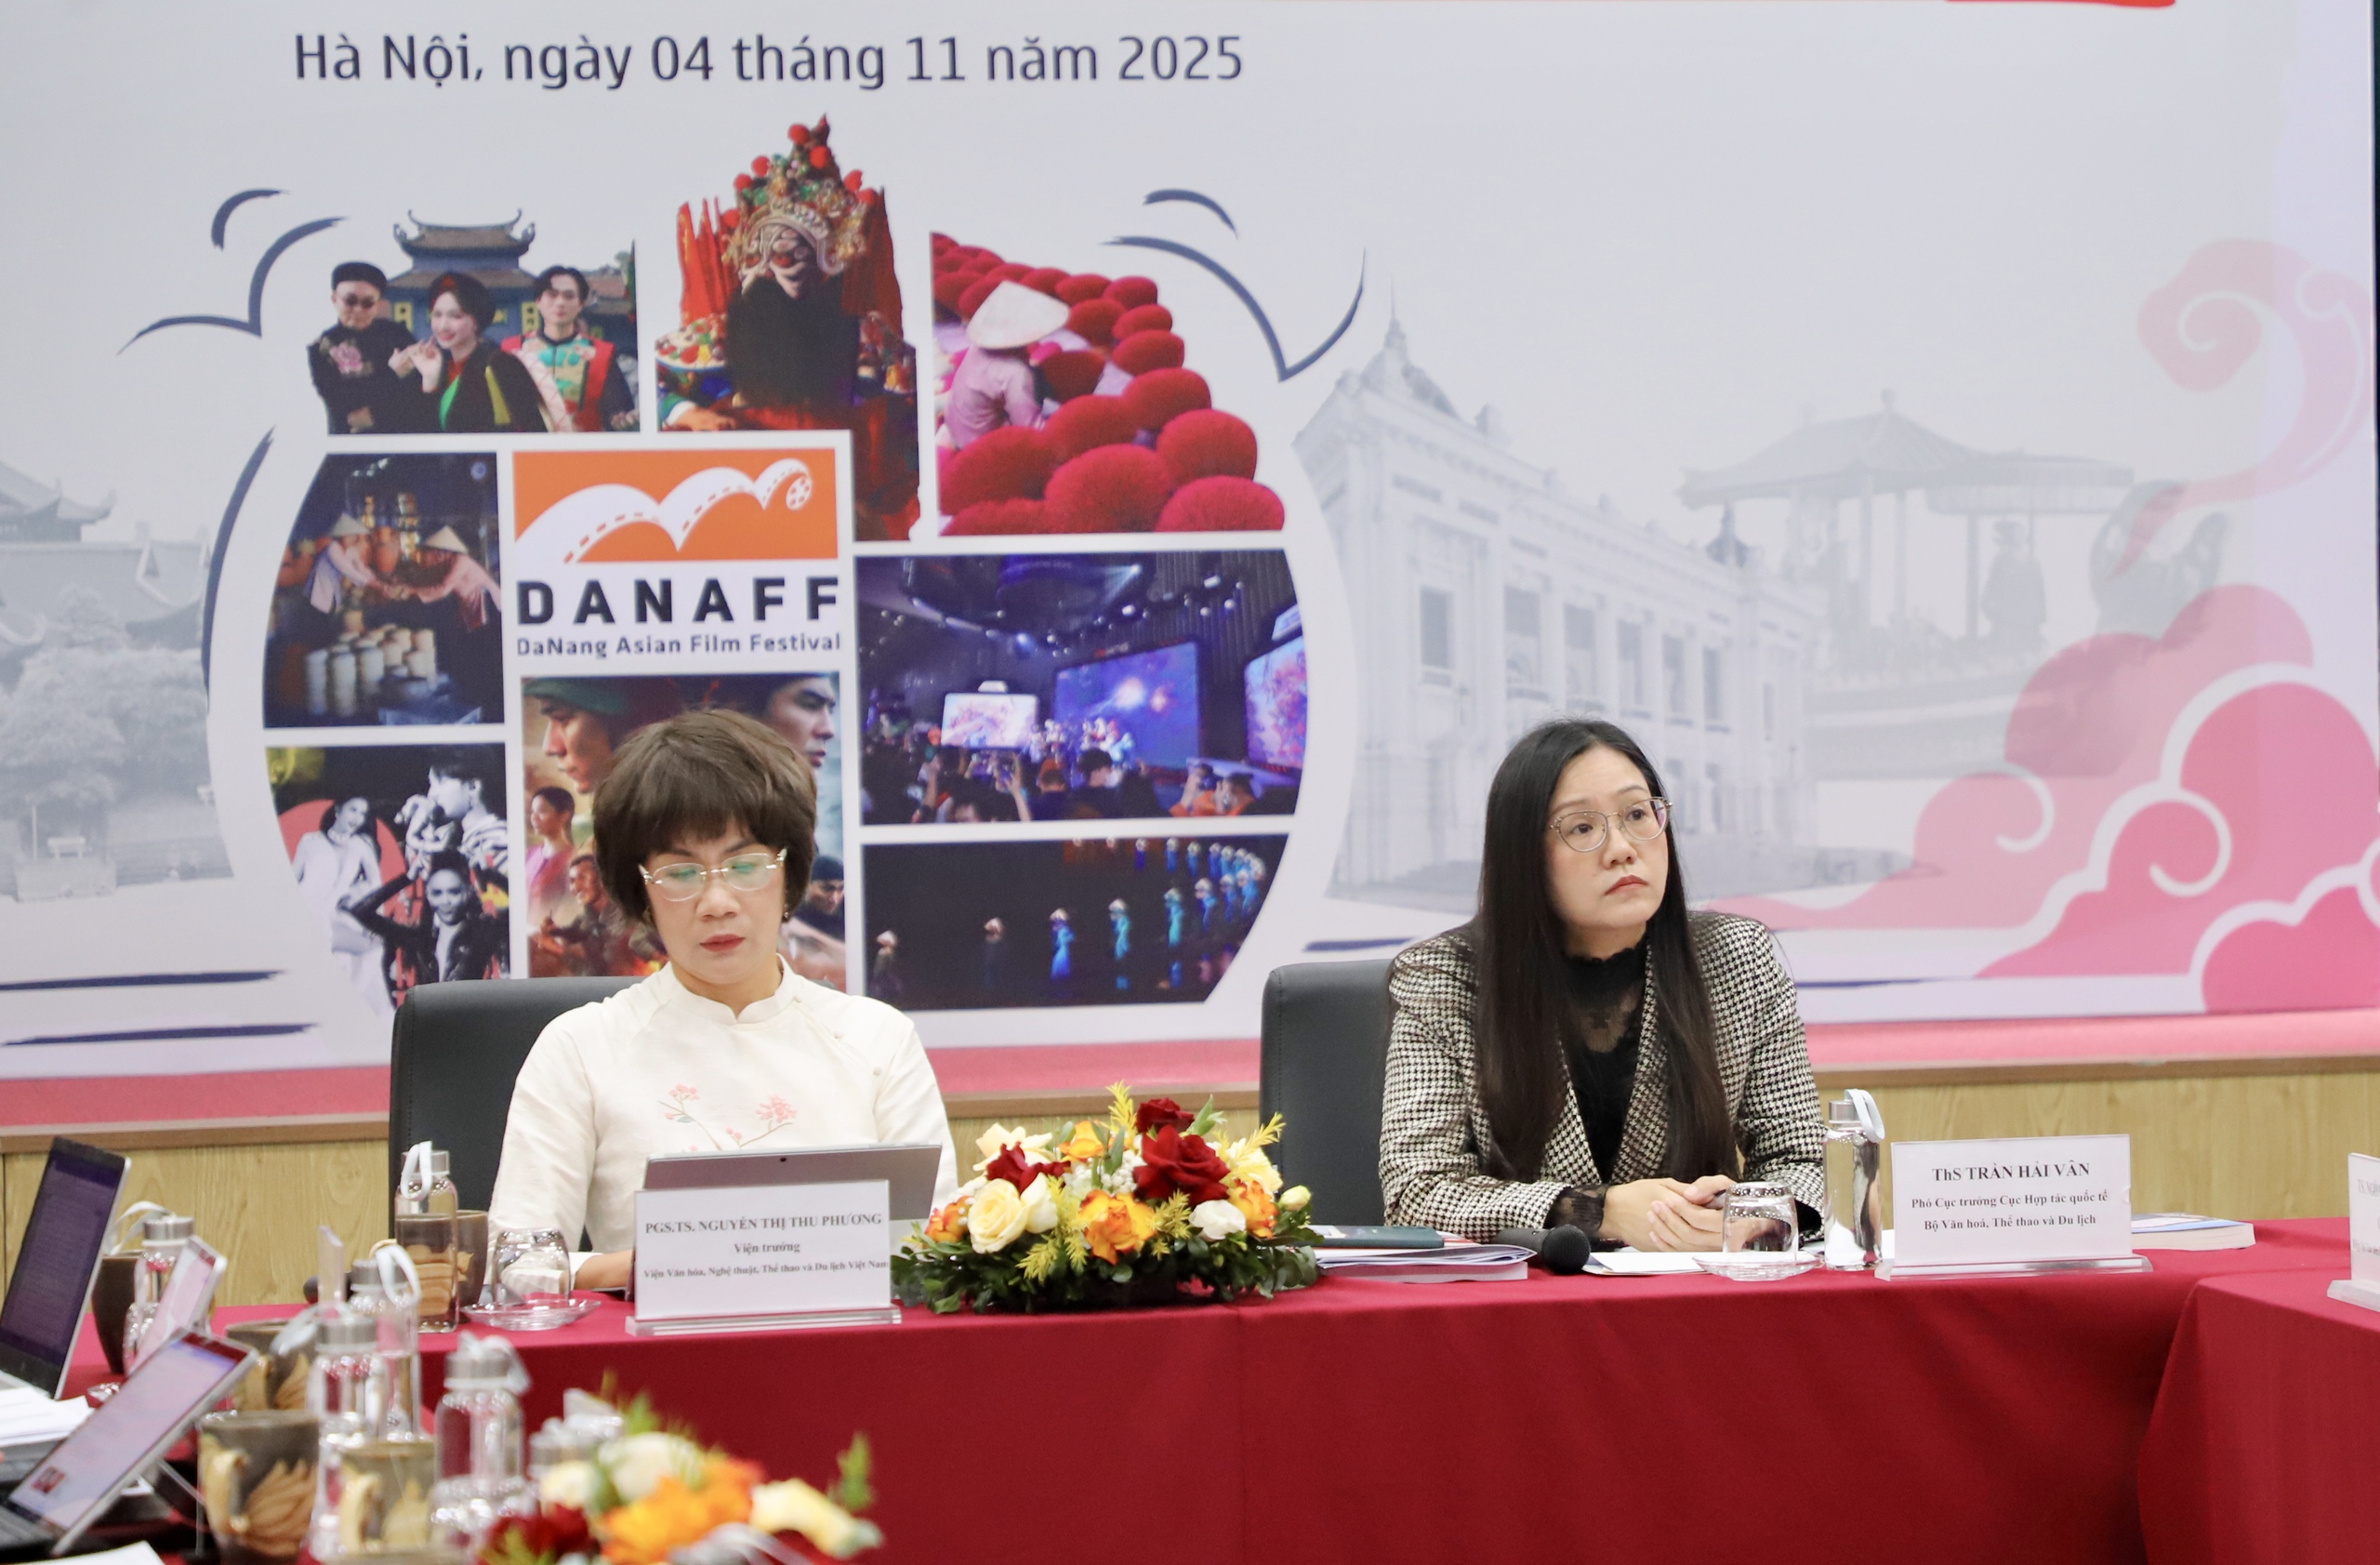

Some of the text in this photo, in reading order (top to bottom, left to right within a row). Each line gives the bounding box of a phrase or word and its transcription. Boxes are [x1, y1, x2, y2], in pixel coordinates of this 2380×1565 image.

[295, 33, 1242, 91] Hà Nội, ngày 04 tháng 11 năm 2025
[517, 577, 839, 626] DANAFF
[517, 632, 840, 659] DaNang Asian Film Festival
[1932, 1167, 1962, 1182] ThS
[2018, 1160, 2049, 1178] HẢI
[2053, 1159, 2090, 1177] VÂN
[1911, 1188, 2109, 1210] Phó Cục trưởng Cục Hợp tác quốc tế
[645, 1221, 695, 1234] PGS.TS.
[760, 1217, 786, 1230] THỊ
[788, 1215, 818, 1227] THU
[821, 1213, 882, 1227] PHƯƠNG
[1924, 1220, 1939, 1233] Bộ
[1942, 1219, 1964, 1229] Văn
[1992, 1214, 2013, 1227] Thể
[2016, 1216, 2040, 1227] thao
[2043, 1215, 2055, 1226] và
[2058, 1214, 2073, 1226] Du
[2077, 1214, 2096, 1227] lịch
[734, 1242, 759, 1255] Viện
[643, 1268, 664, 1280] Viện
[708, 1266, 731, 1277] Nghệ
[781, 1263, 800, 1272] thao
[802, 1262, 813, 1271] và
[814, 1262, 827, 1271] Du
[829, 1261, 845, 1272] lịch
[848, 1260, 866, 1271] Việt
